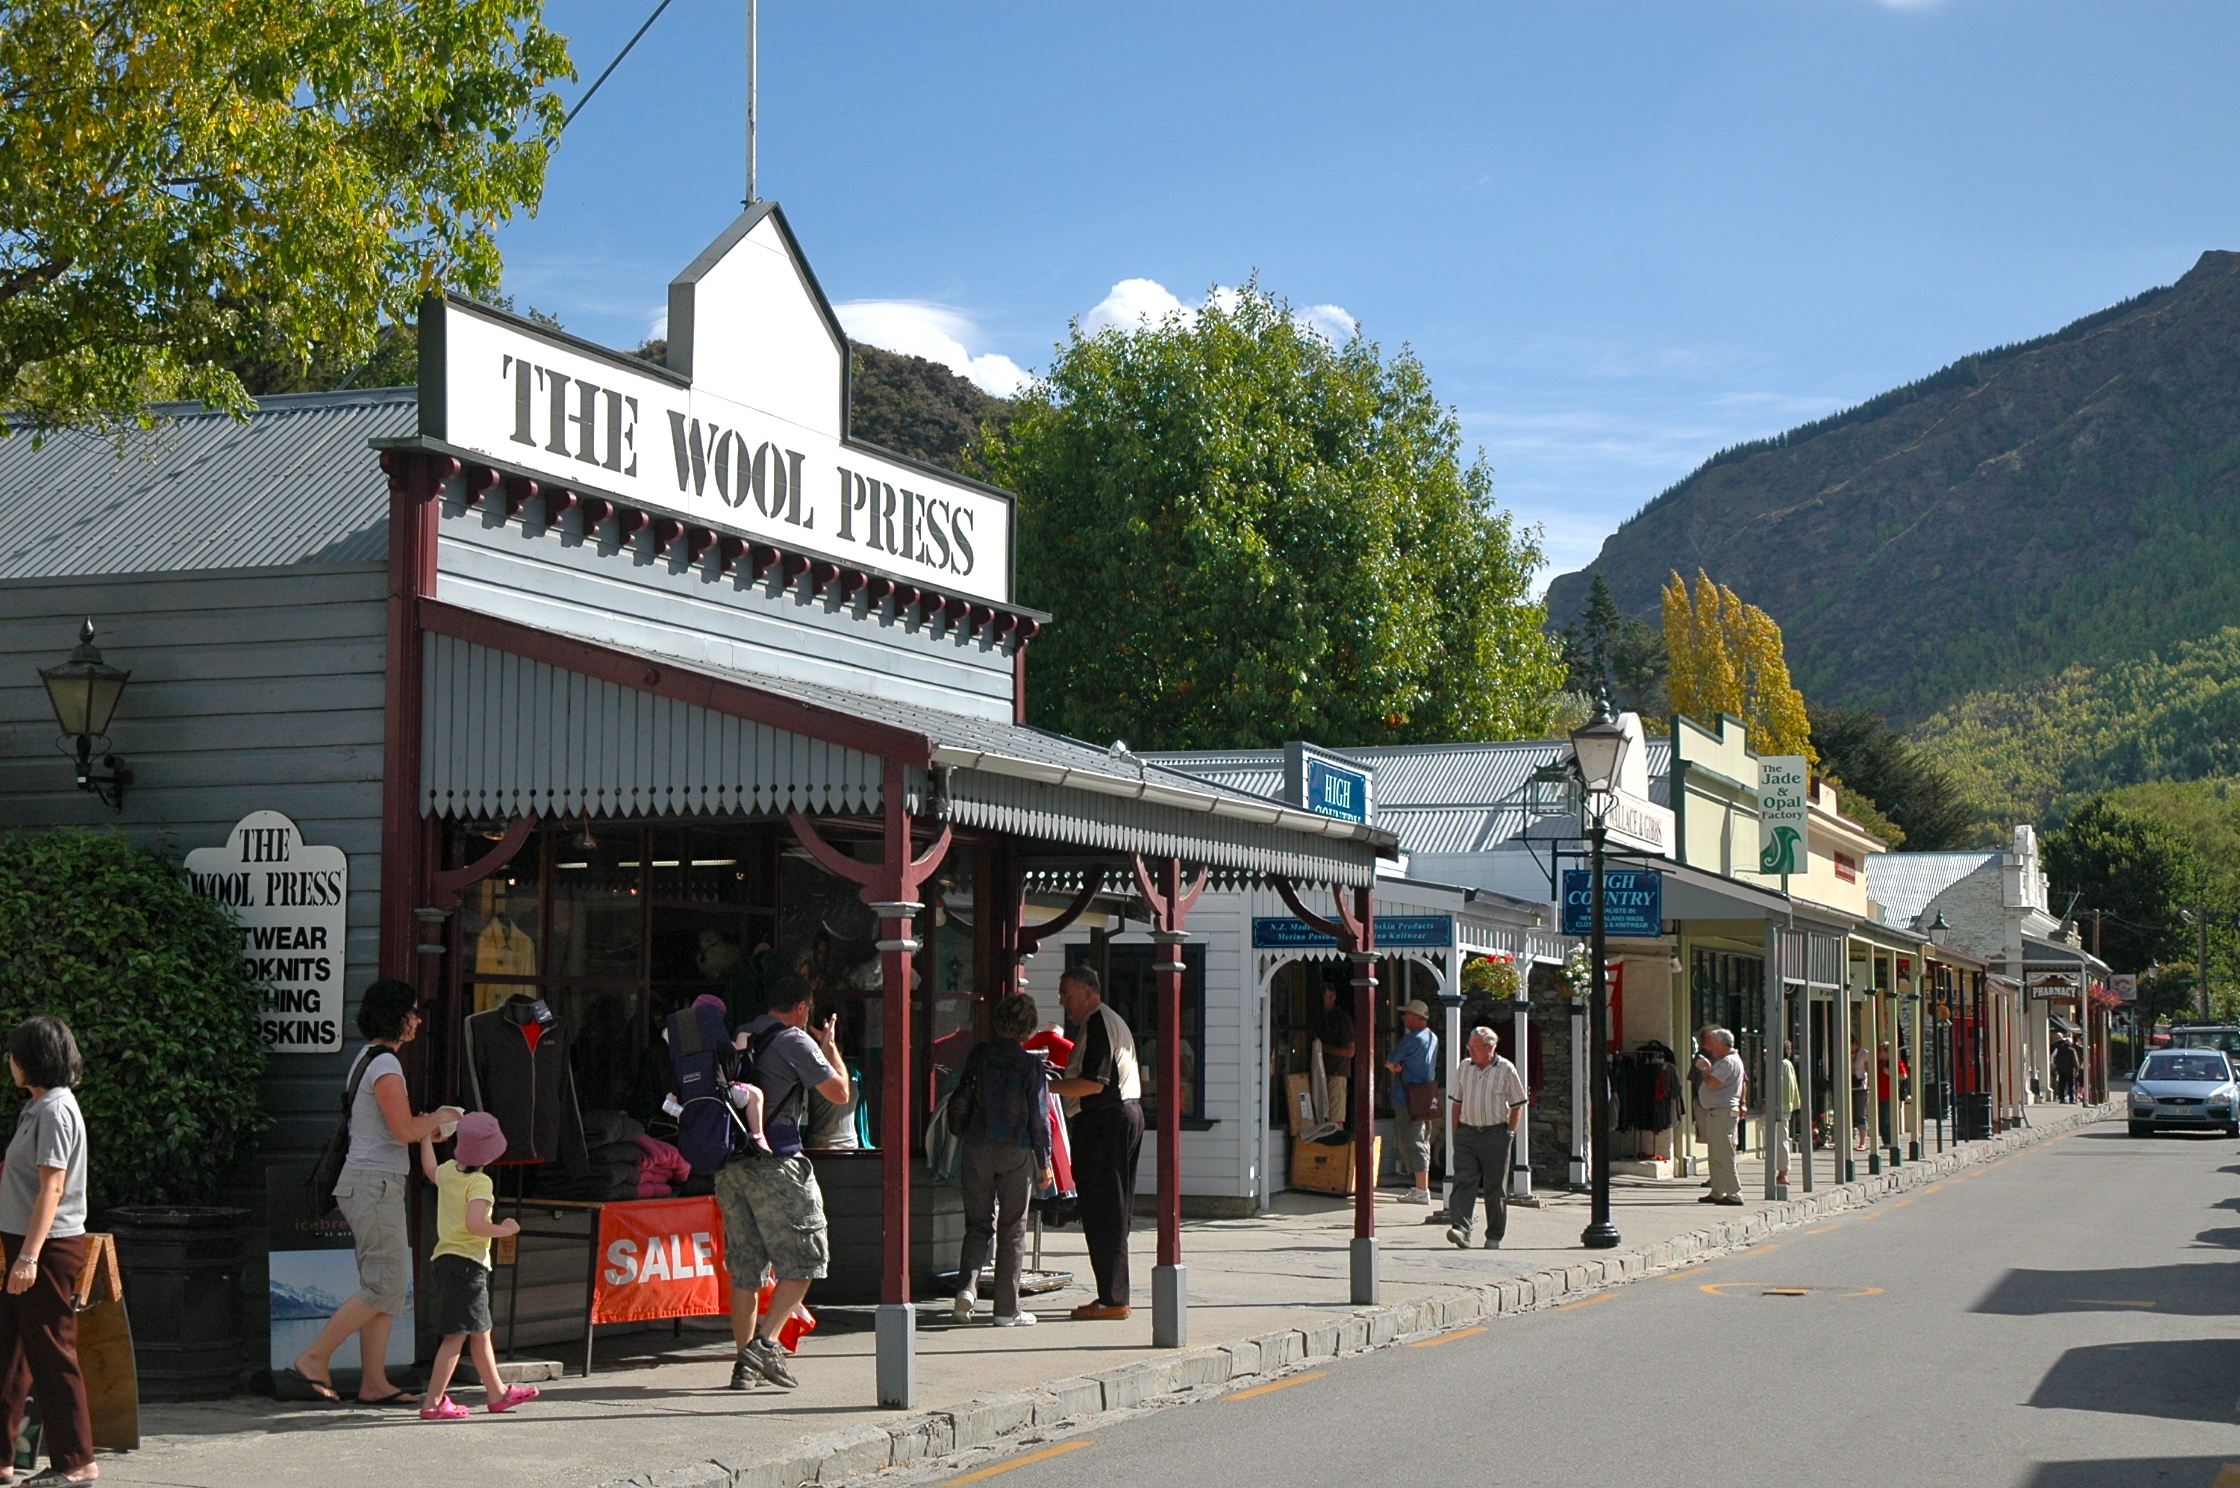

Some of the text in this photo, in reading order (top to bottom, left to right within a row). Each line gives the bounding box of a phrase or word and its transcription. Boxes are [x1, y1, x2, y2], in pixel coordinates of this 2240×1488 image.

[502, 353, 975, 577] THE WOOL PRESS
[1762, 764, 1782, 773] The
[1761, 772, 1801, 785] Jade
[1324, 773, 1352, 809] HIGH
[1777, 786, 1789, 797] &
[1763, 796, 1801, 811] Opal
[1761, 810, 1804, 821] Factory
[239, 828, 291, 863] THE
[190, 870, 342, 907] WOOL PRESS
[1567, 890, 1656, 906] CONTRY
[1270, 923, 1287, 931] N.Z.
[1398, 922, 1434, 930] Products
[1278, 932, 1306, 941] Merino
[1389, 931, 1427, 940] Knitwear
[2032, 986, 2077, 999] PHARMACY
[604, 1231, 715, 1286] SALE
